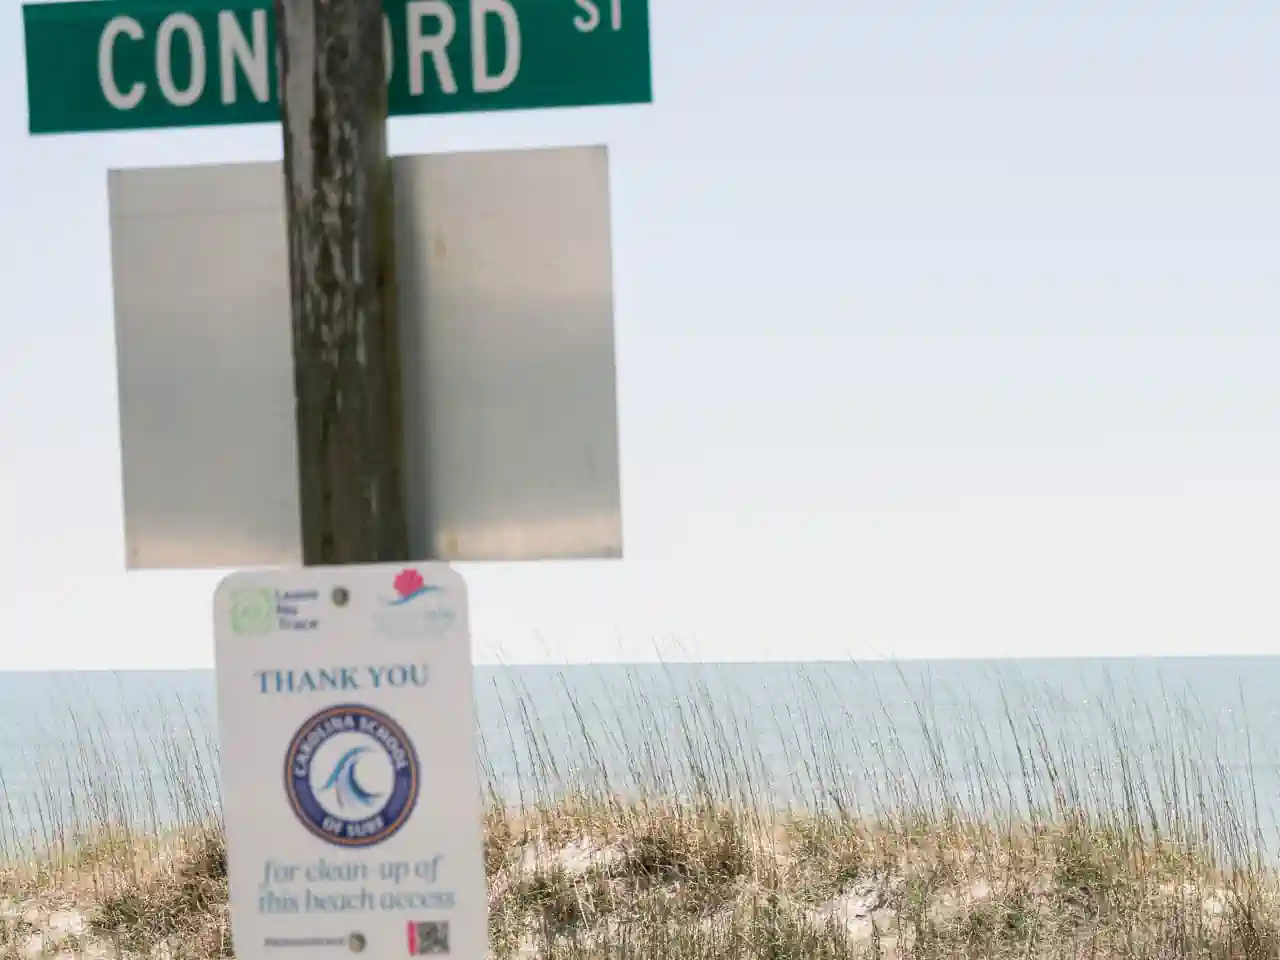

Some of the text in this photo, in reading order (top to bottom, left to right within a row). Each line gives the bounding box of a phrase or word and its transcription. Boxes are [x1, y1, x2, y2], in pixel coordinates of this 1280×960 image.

[98, 0, 522, 110] CONRD
[254, 663, 429, 694] THANK YOU
[258, 858, 299, 889] for
[414, 853, 446, 884] of
[306, 887, 376, 912] beach
[379, 890, 456, 910] access
